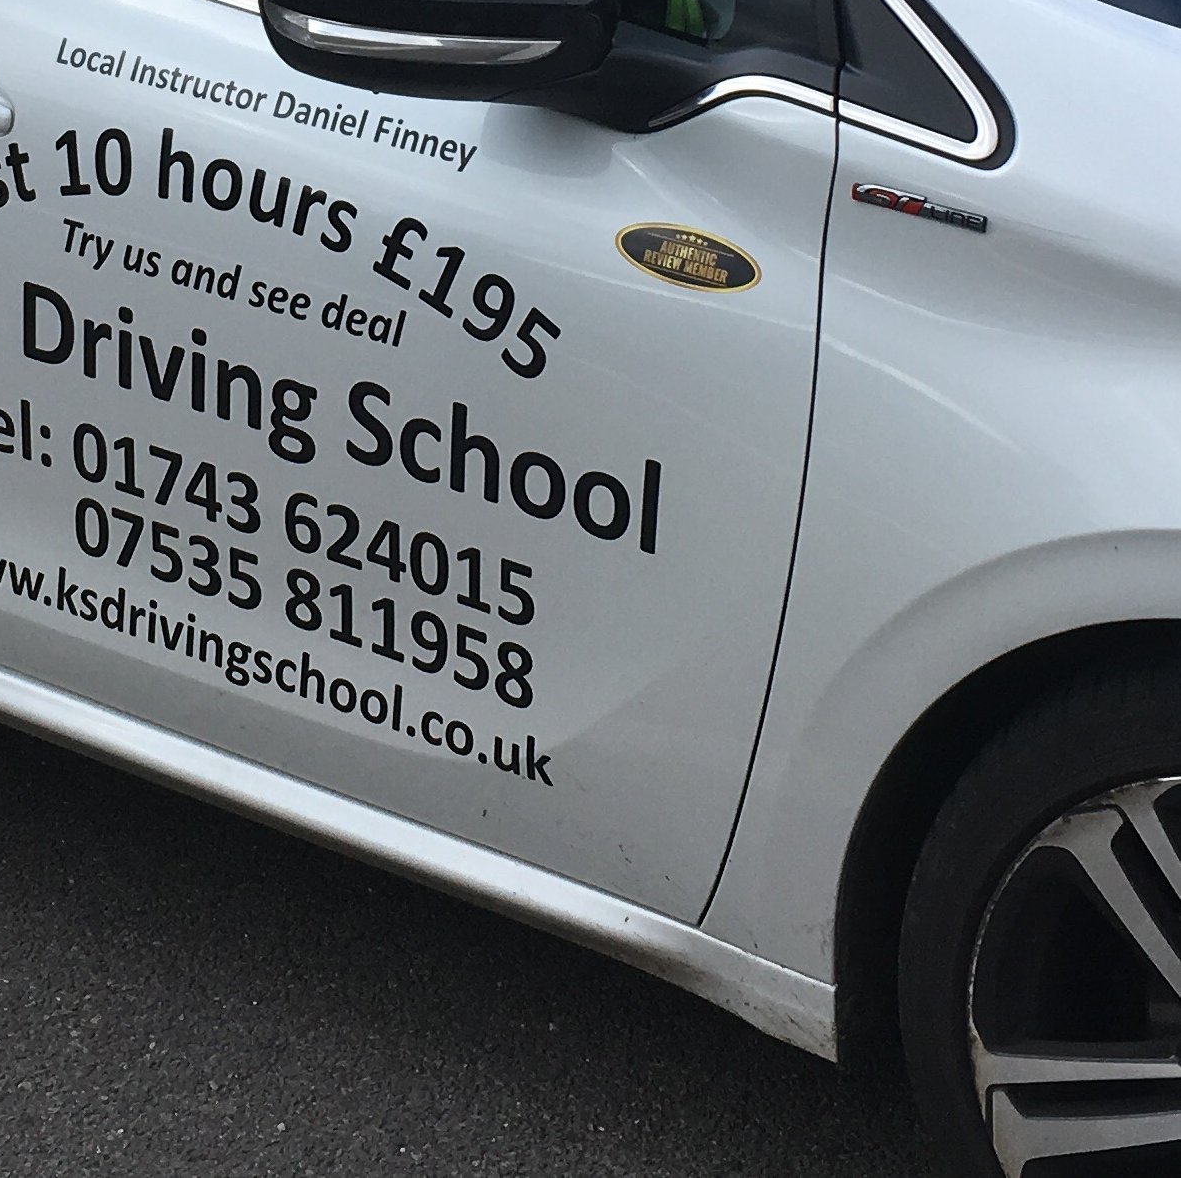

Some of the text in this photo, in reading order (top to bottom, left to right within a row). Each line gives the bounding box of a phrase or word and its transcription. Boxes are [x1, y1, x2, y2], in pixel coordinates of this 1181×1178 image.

[56, 37, 479, 172] Local Instructor Daniel Finney
[55, 128, 132, 197] 10
[158, 127, 359, 253] hours
[372, 217, 563, 379] £195
[62, 218, 408, 347] Try us and see deal
[642, 248, 729, 284] REVIEW MEMBER
[659, 240, 718, 266] AUTHENTIC
[23, 281, 317, 465] Driving
[345, 380, 662, 555] School
[73, 422, 262, 534] 01743
[284, 492, 536, 625] 624015
[75, 497, 535, 709] 07535 811958
